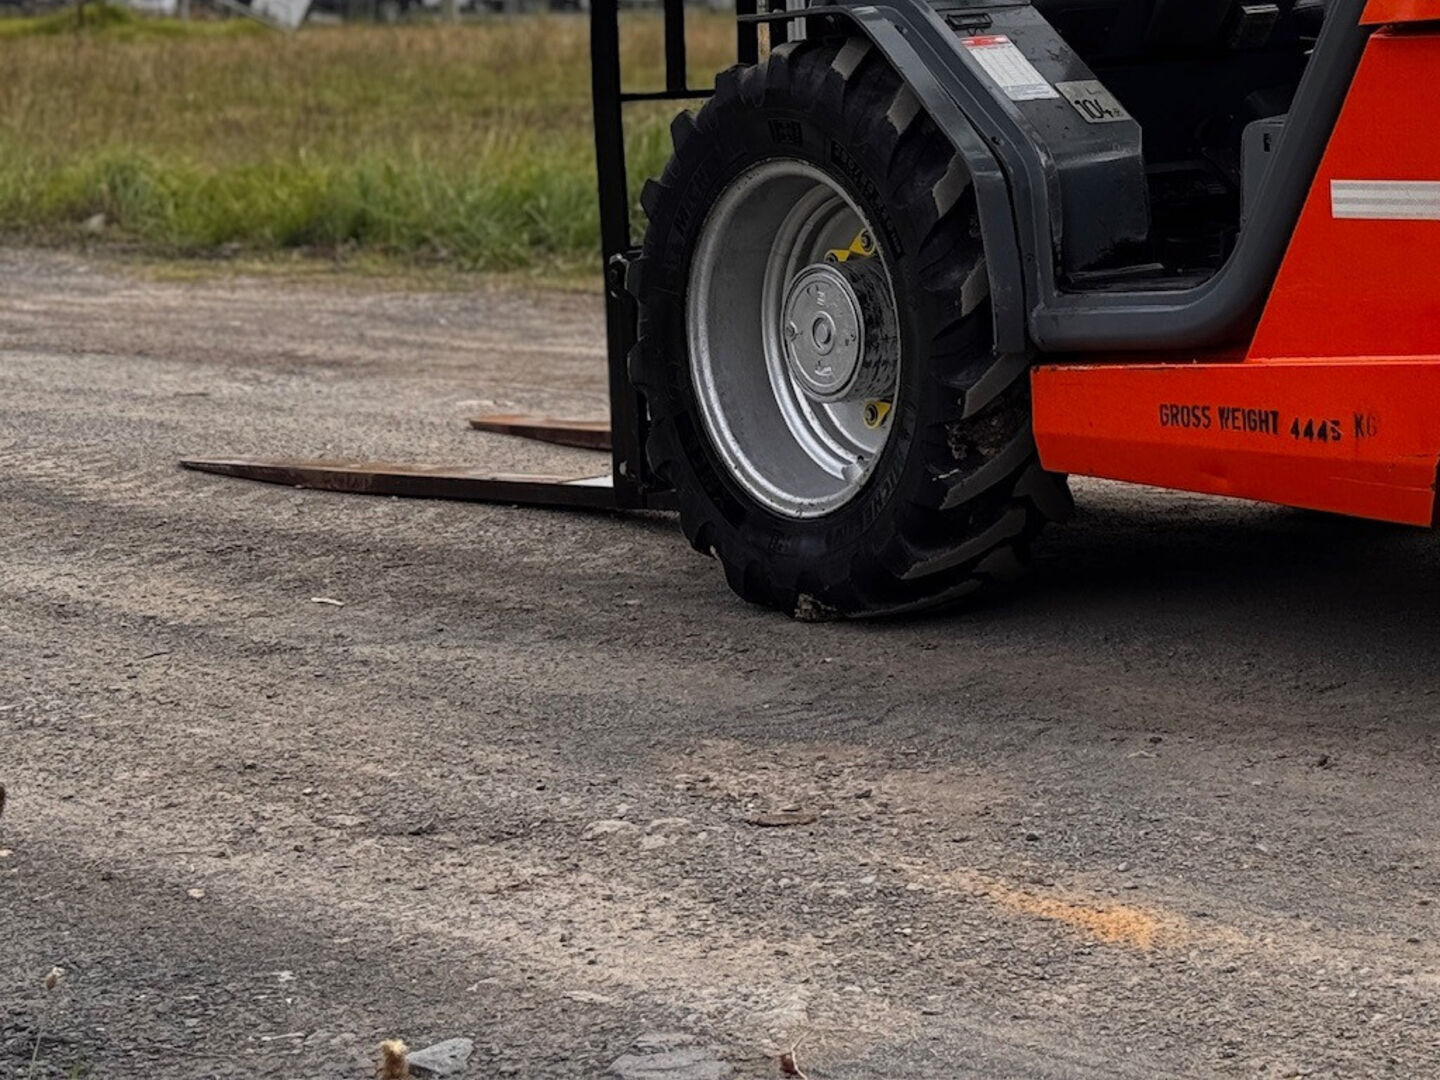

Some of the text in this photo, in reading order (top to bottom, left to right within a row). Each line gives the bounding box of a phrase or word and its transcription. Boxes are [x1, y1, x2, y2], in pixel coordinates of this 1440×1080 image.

[1159, 403, 1211, 429] GROSS
[1217, 407, 1279, 435] WEIGHT
[1353, 412, 1379, 438] KG
